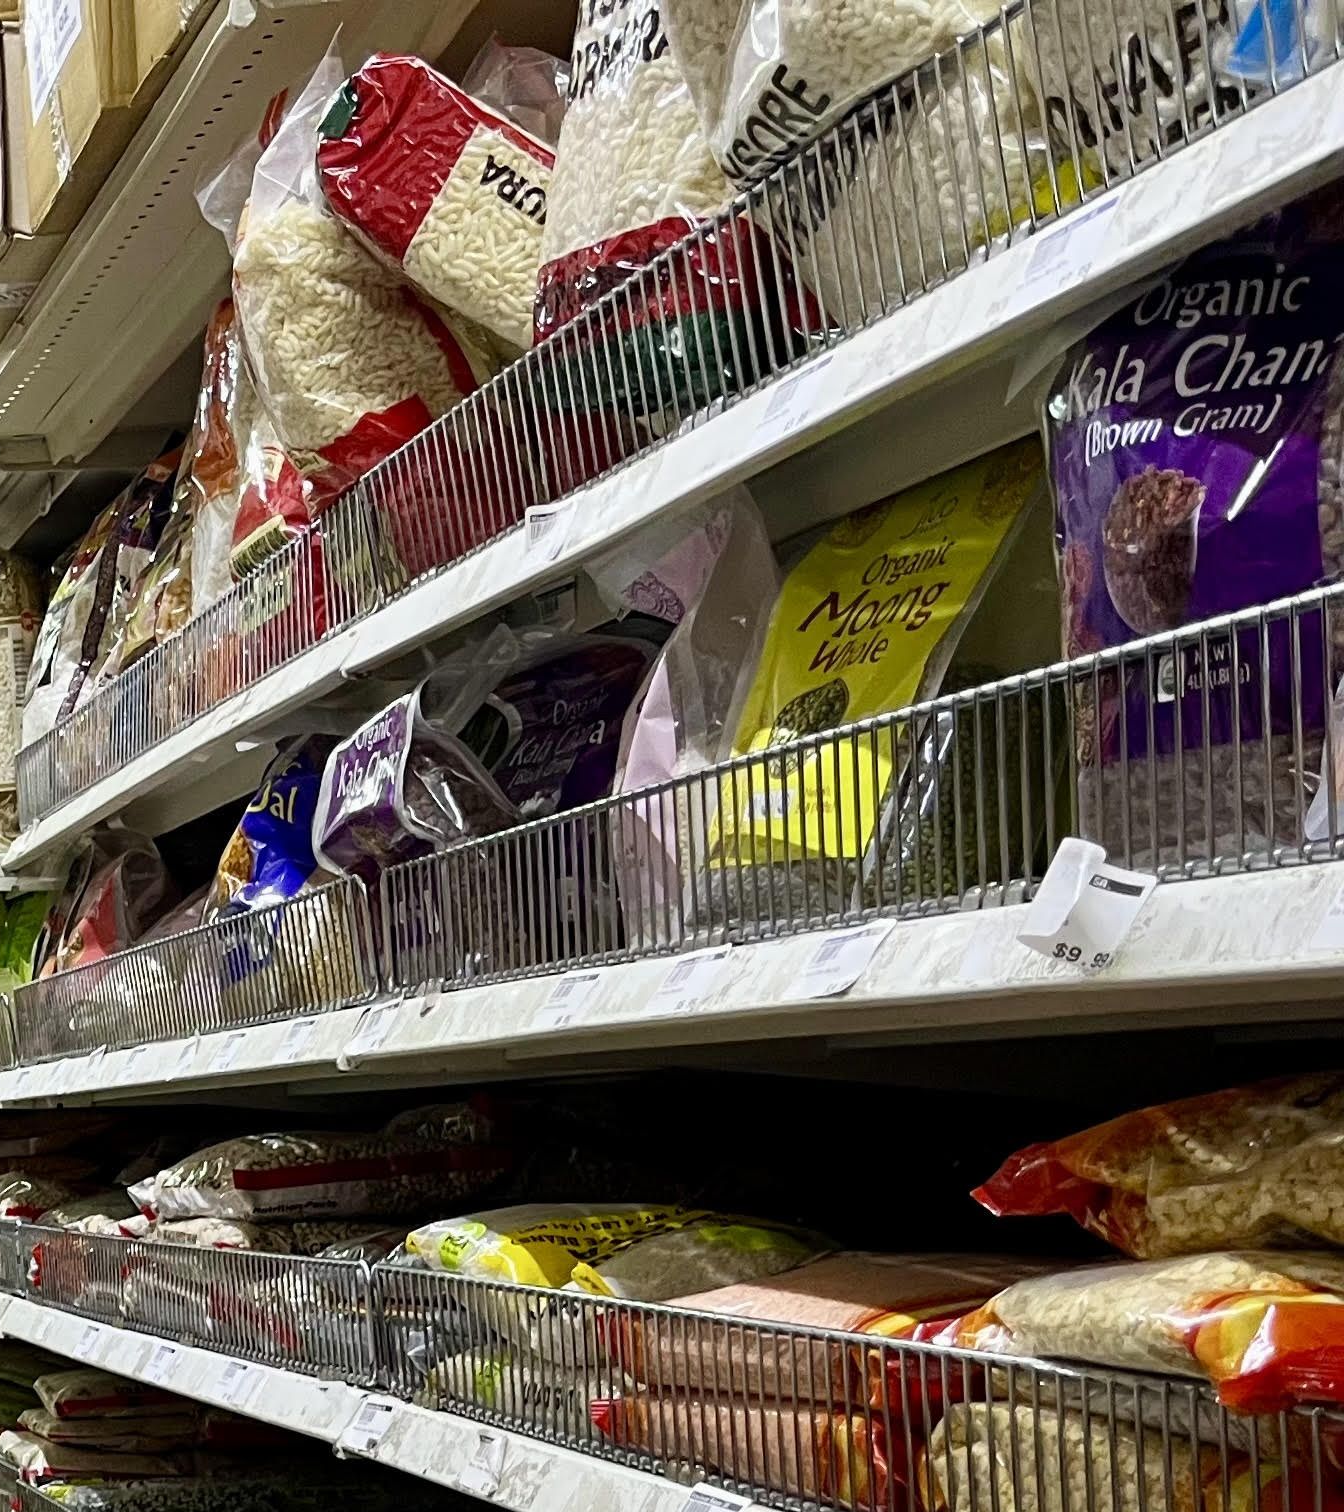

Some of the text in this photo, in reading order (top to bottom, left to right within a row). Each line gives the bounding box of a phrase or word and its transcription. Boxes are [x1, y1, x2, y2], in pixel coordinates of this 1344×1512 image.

[1136, 267, 1311, 328] Organic
[1084, 393, 1283, 467] (Brown Gram)
[859, 539, 952, 588] Organic
[797, 583, 950, 638] Moong
[809, 629, 889, 673] Whole
